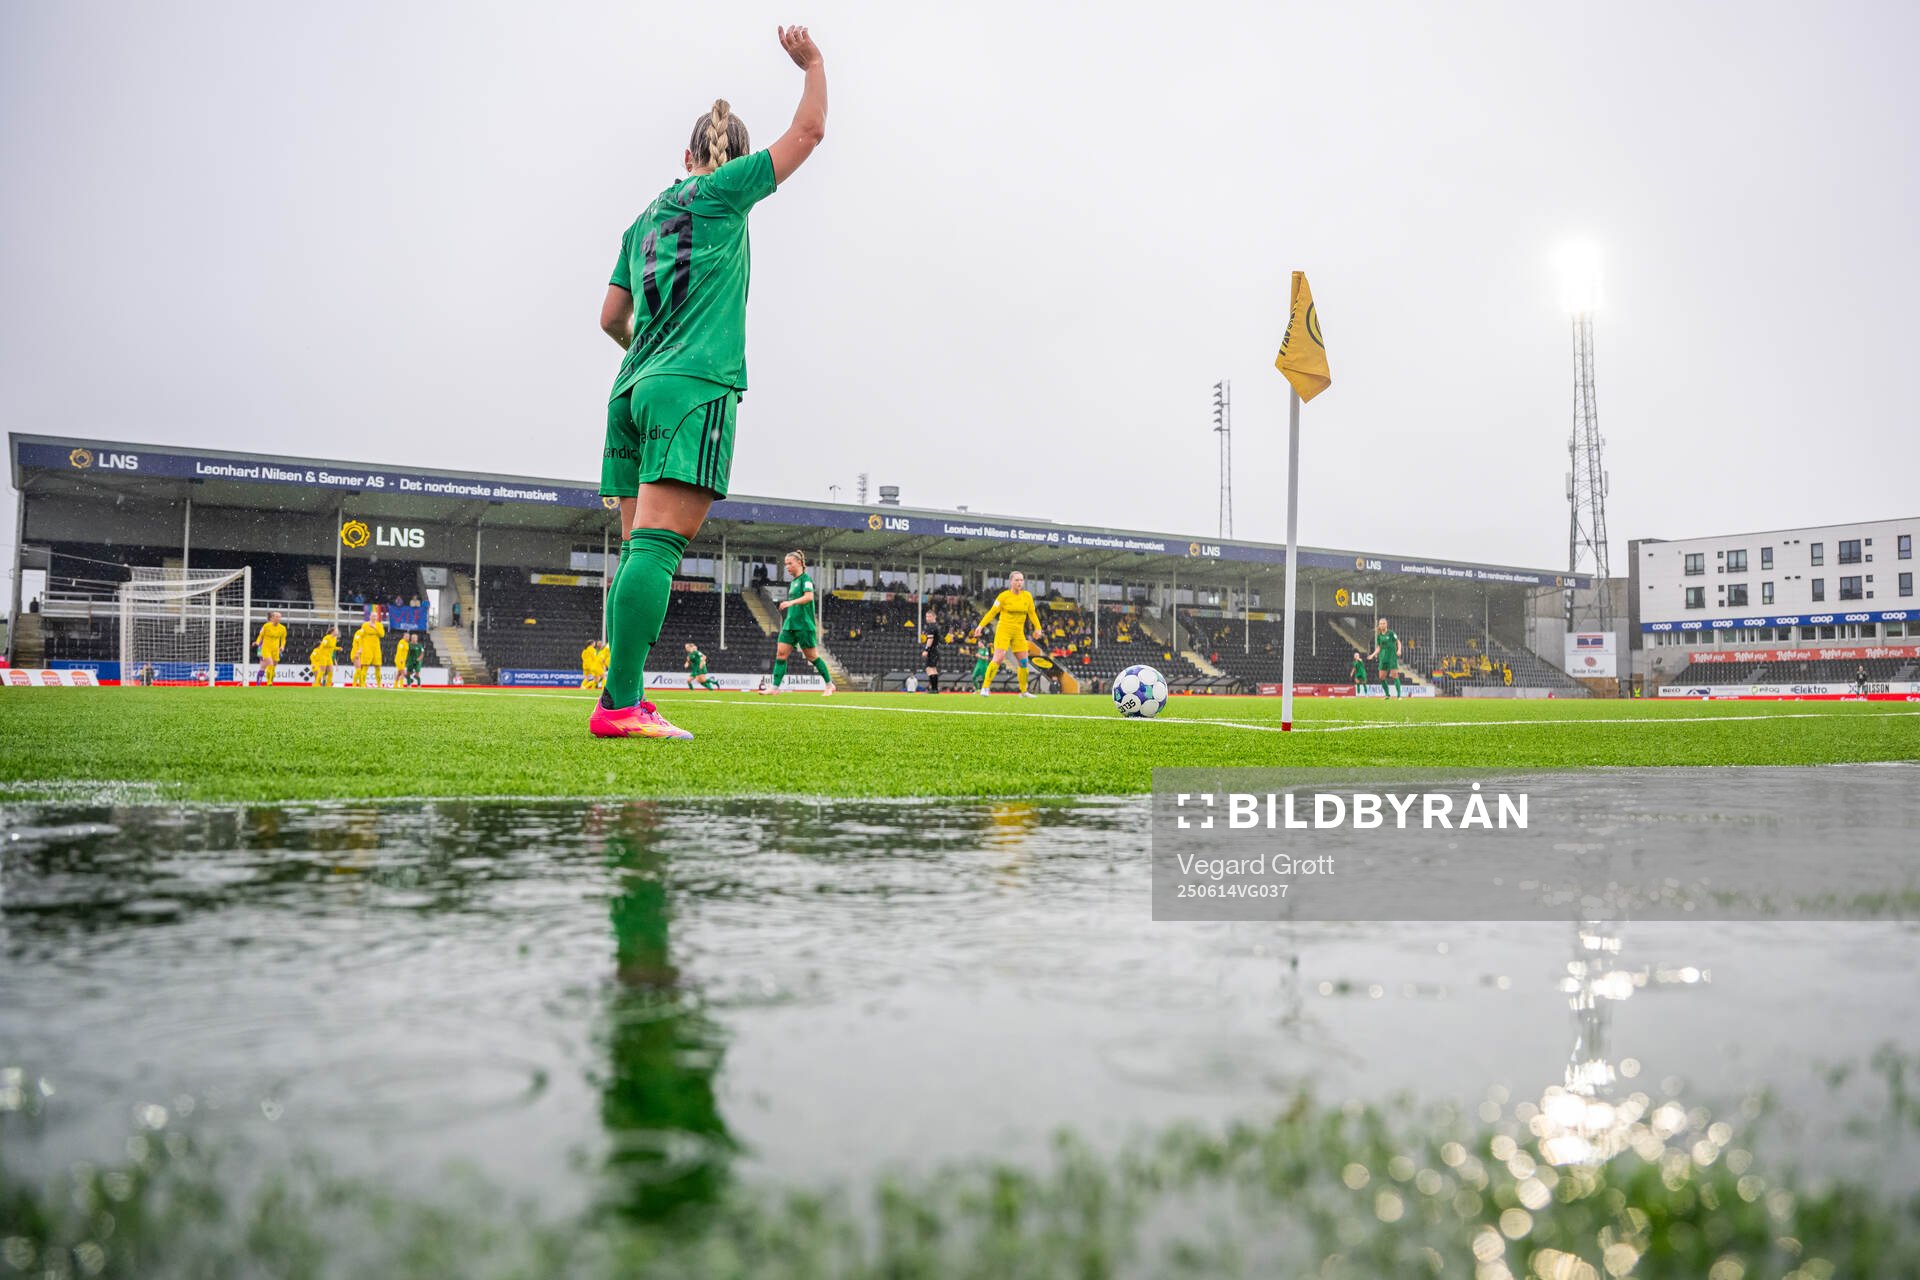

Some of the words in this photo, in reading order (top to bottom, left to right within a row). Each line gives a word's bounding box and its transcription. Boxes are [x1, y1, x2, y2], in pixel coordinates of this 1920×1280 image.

[641, 211, 694, 319] 17
[98, 453, 139, 470] LNS
[196, 462, 259, 478] Leonhard
[261, 467, 302, 482] Nilsen
[305, 471, 316, 483] &
[319, 472, 364, 486] Sønner
[366, 476, 385, 488] AS
[400, 478, 422, 490] Det
[424, 482, 491, 496] nordnorske
[493, 487, 558, 501] alternativet
[885, 518, 909, 531] LNS
[376, 526, 425, 548] LNS
[944, 523, 983, 536] Leonhard
[984, 527, 1010, 538] Nilsen
[1010, 529, 1018, 539] &
[1047, 532, 1059, 543] AS
[1067, 534, 1082, 544] Det
[1082, 536, 1124, 548] nordnorske
[1124, 539, 1165, 551] alternativet
[1202, 545, 1221, 557] LNS
[1366, 559, 1382, 571] LNS
[1563, 577, 1576, 587] LNS
[1351, 591, 1374, 607] LNS
[1776, 617, 1799, 625] coop
[1810, 615, 1834, 623] coop
[1845, 613, 1870, 622] coop
[1881, 611, 1907, 620] coop
[1652, 623, 1672, 631] coop
[1712, 620, 1733, 628] coop
[1744, 618, 1766, 626] coop
